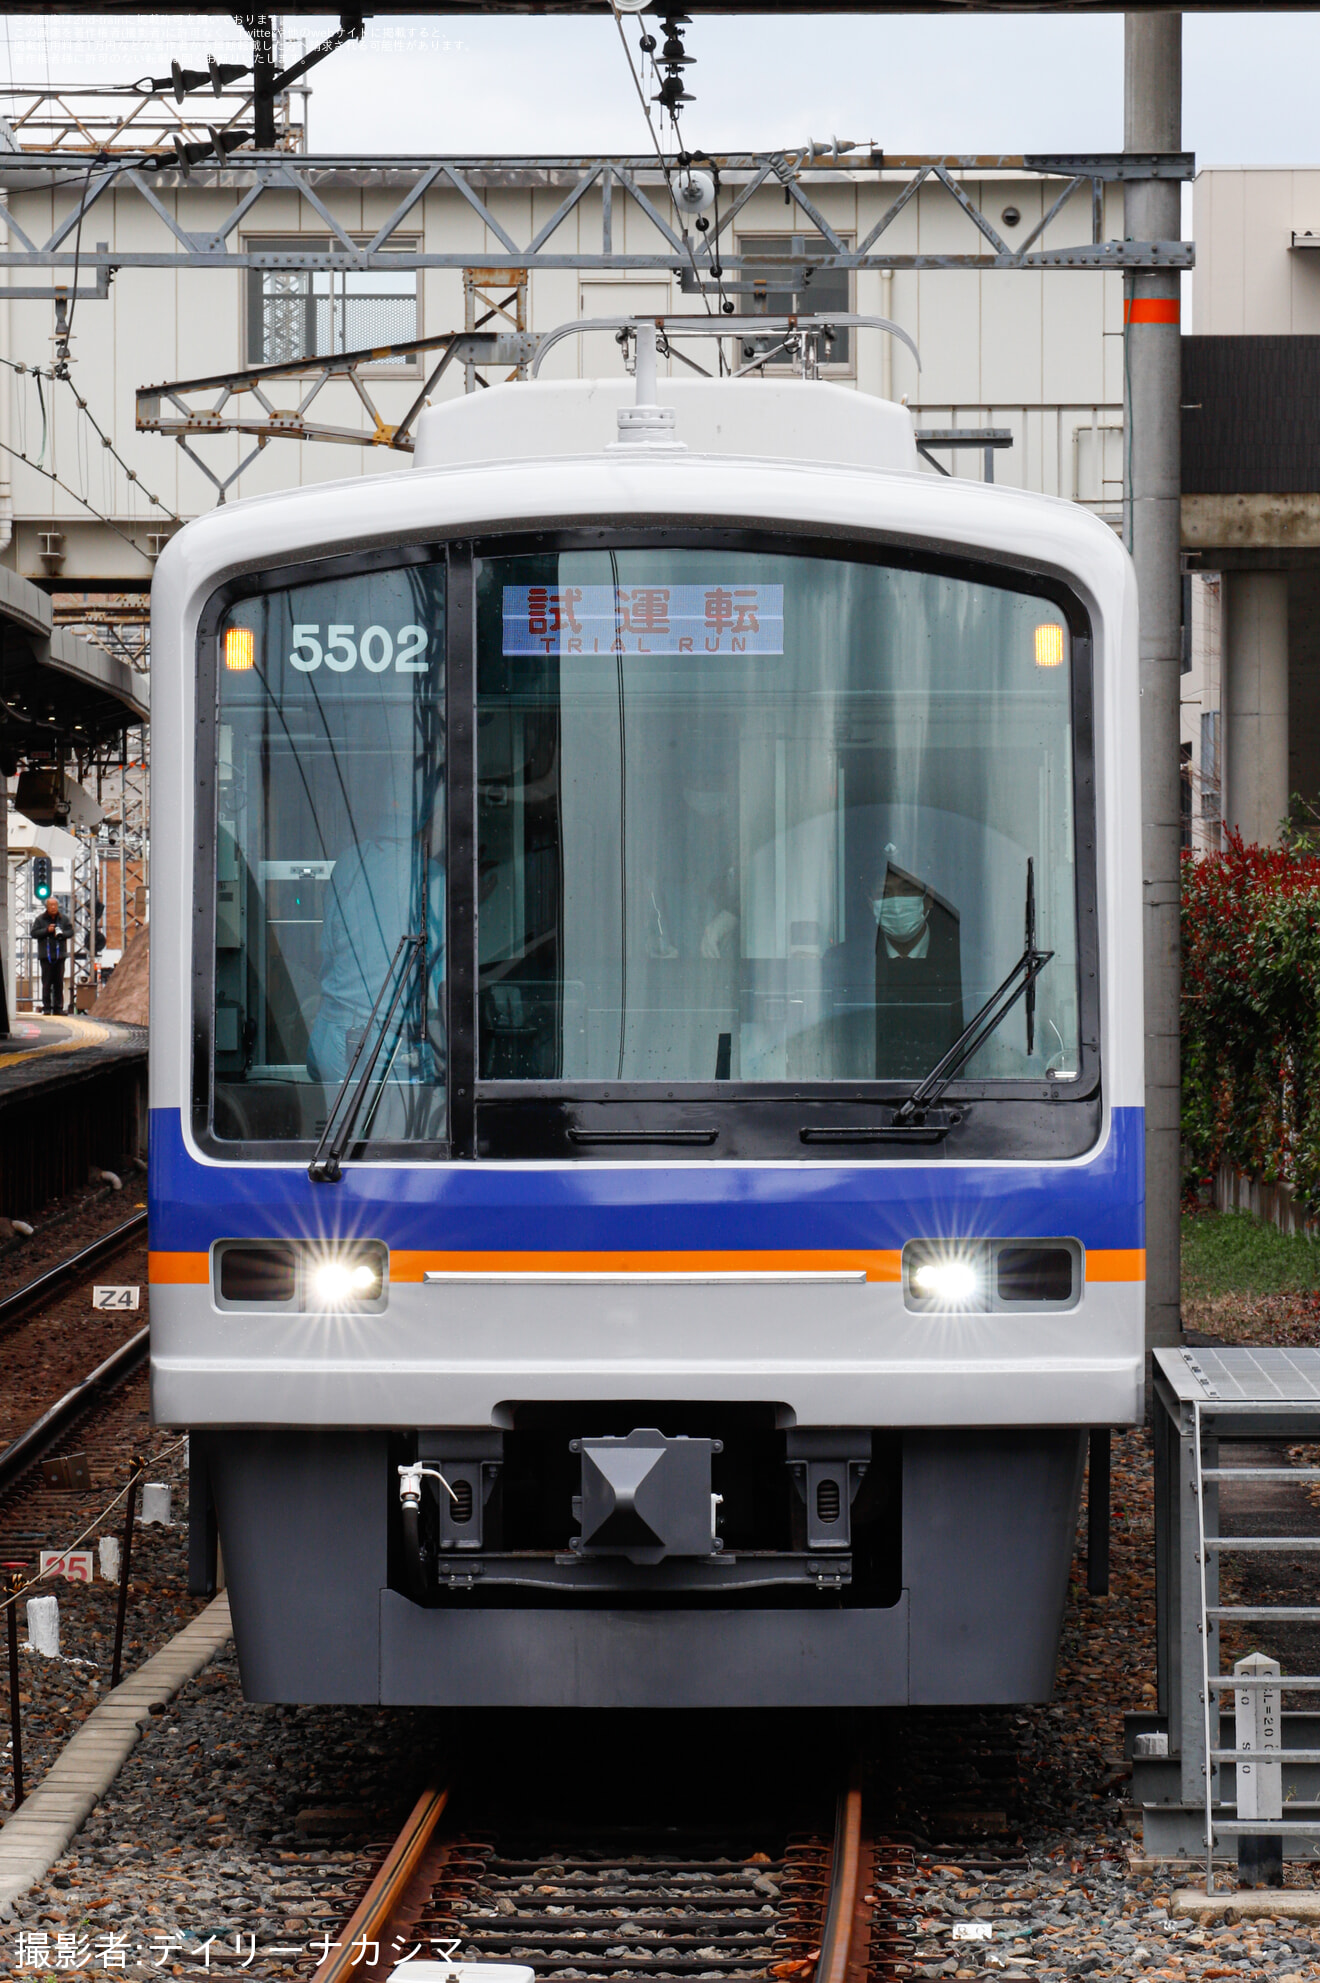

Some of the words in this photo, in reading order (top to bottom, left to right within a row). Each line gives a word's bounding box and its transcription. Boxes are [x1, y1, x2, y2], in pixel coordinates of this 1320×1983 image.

[527, 588, 760, 635] 試運転
[289, 624, 429, 673] 5502
[540, 637, 652, 653] TRIAL
[678, 637, 747, 653] RUN
[98, 1290, 133, 1307] Z4
[45, 1556, 88, 1582] 25
